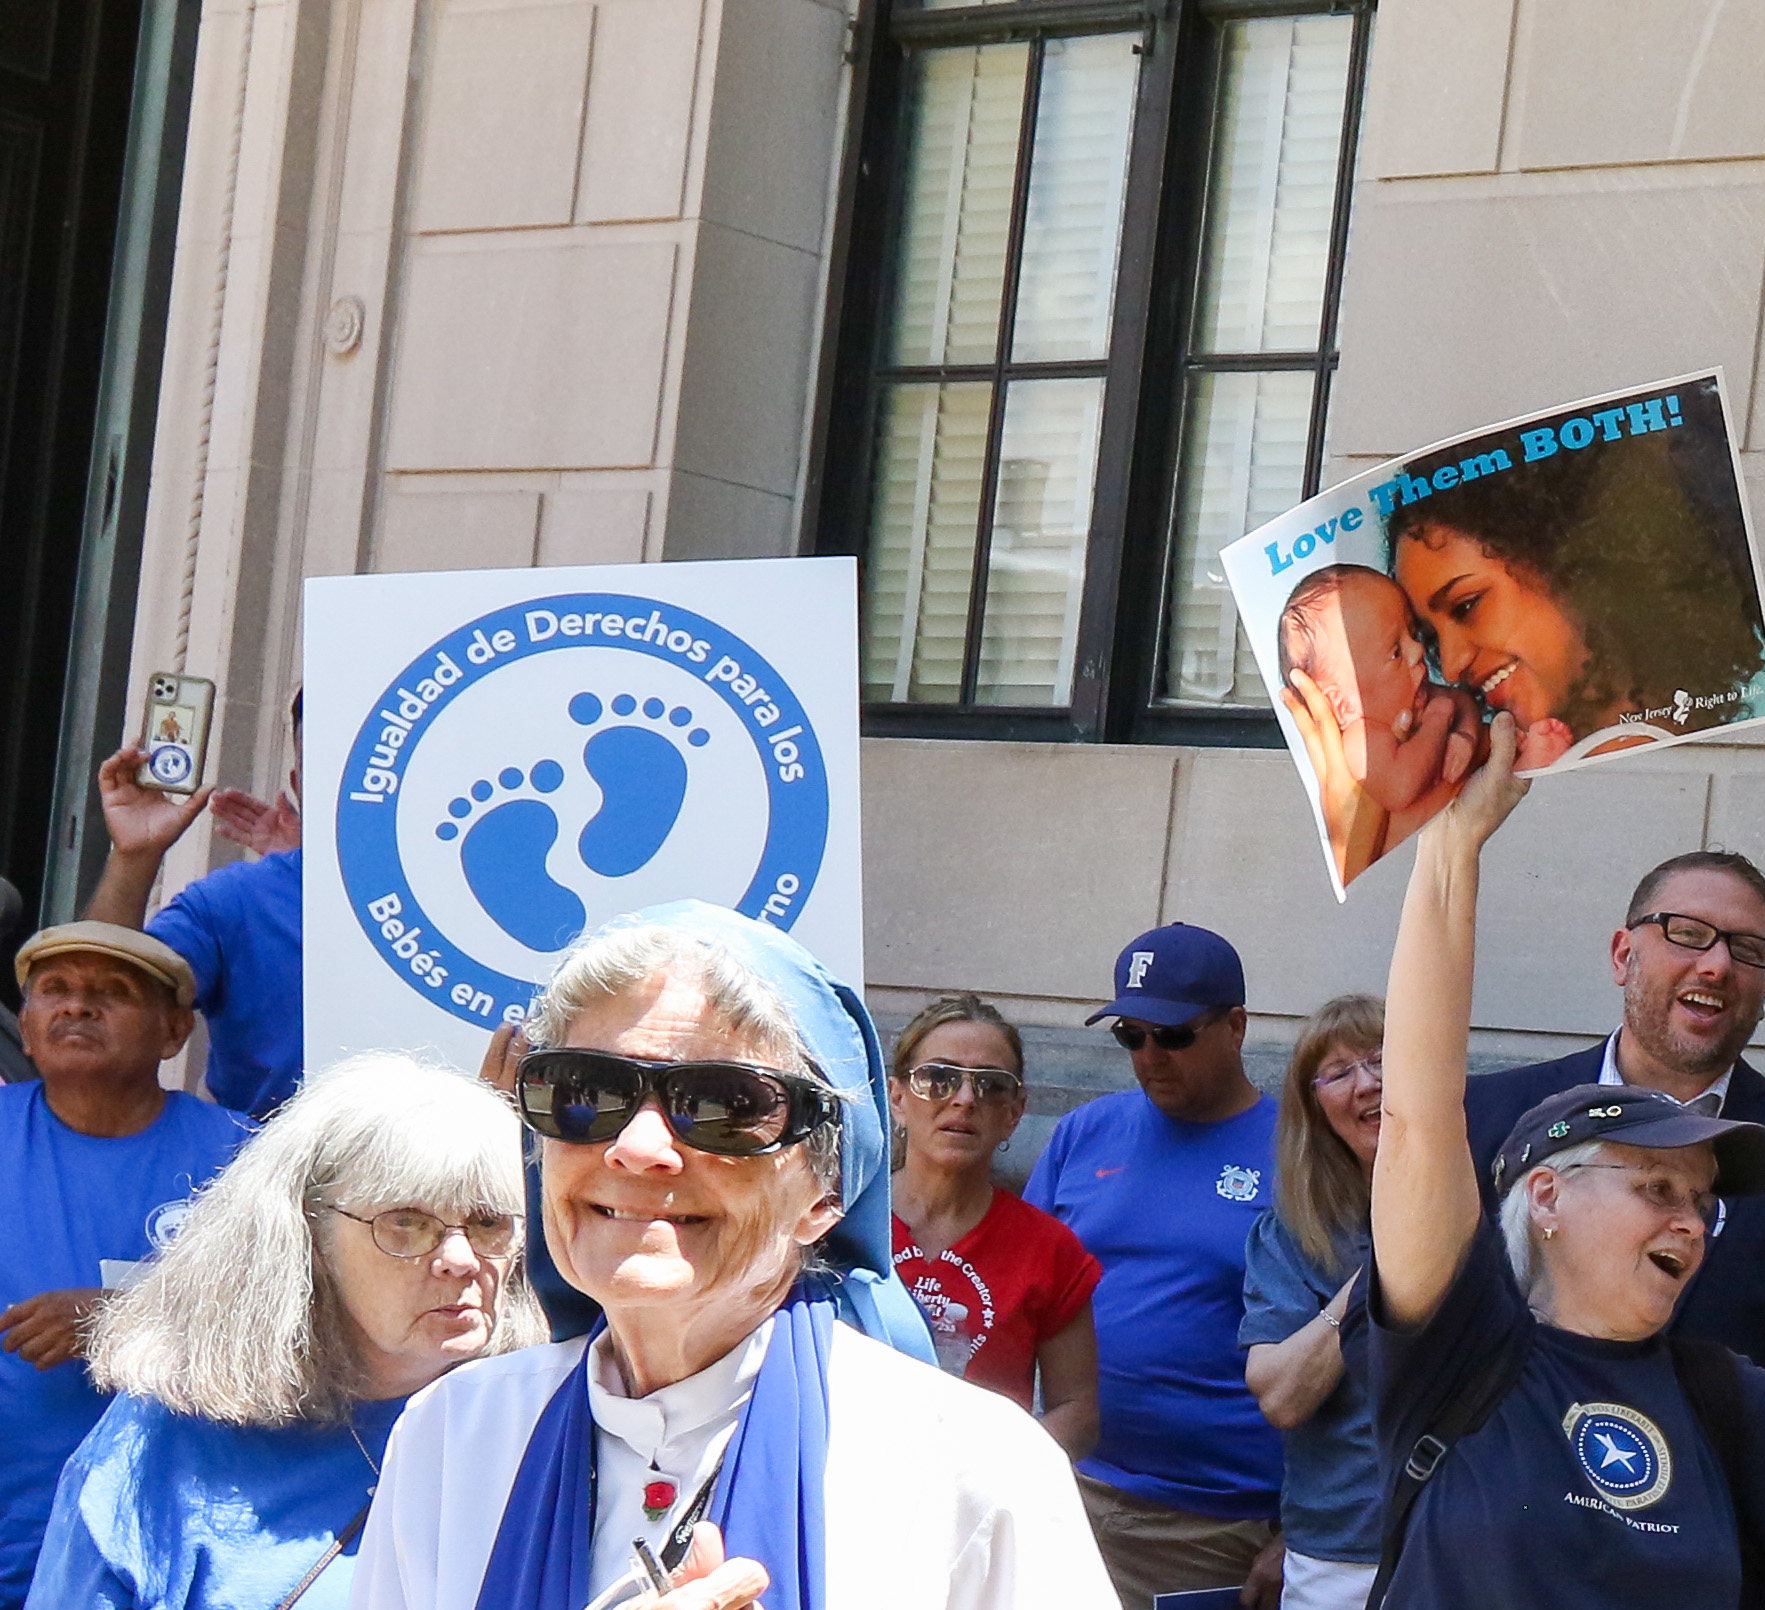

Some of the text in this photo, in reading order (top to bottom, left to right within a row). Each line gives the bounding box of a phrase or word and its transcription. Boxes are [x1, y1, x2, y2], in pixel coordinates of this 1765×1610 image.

[1263, 394, 1684, 576] Love Them BOTH!
[351, 608, 805, 803] Igualdad de Derechos para los
[1695, 693, 1725, 710] Right
[1727, 691, 1738, 701] to
[367, 892, 445, 989] Bebés
[451, 981, 495, 1018] en
[1126, 951, 1154, 988] F
[915, 1276, 942, 1292] Life
[940, 1250, 963, 1266] the
[962, 1263, 993, 1307] Creator
[1625, 1516, 1680, 1534] PATRIOT
